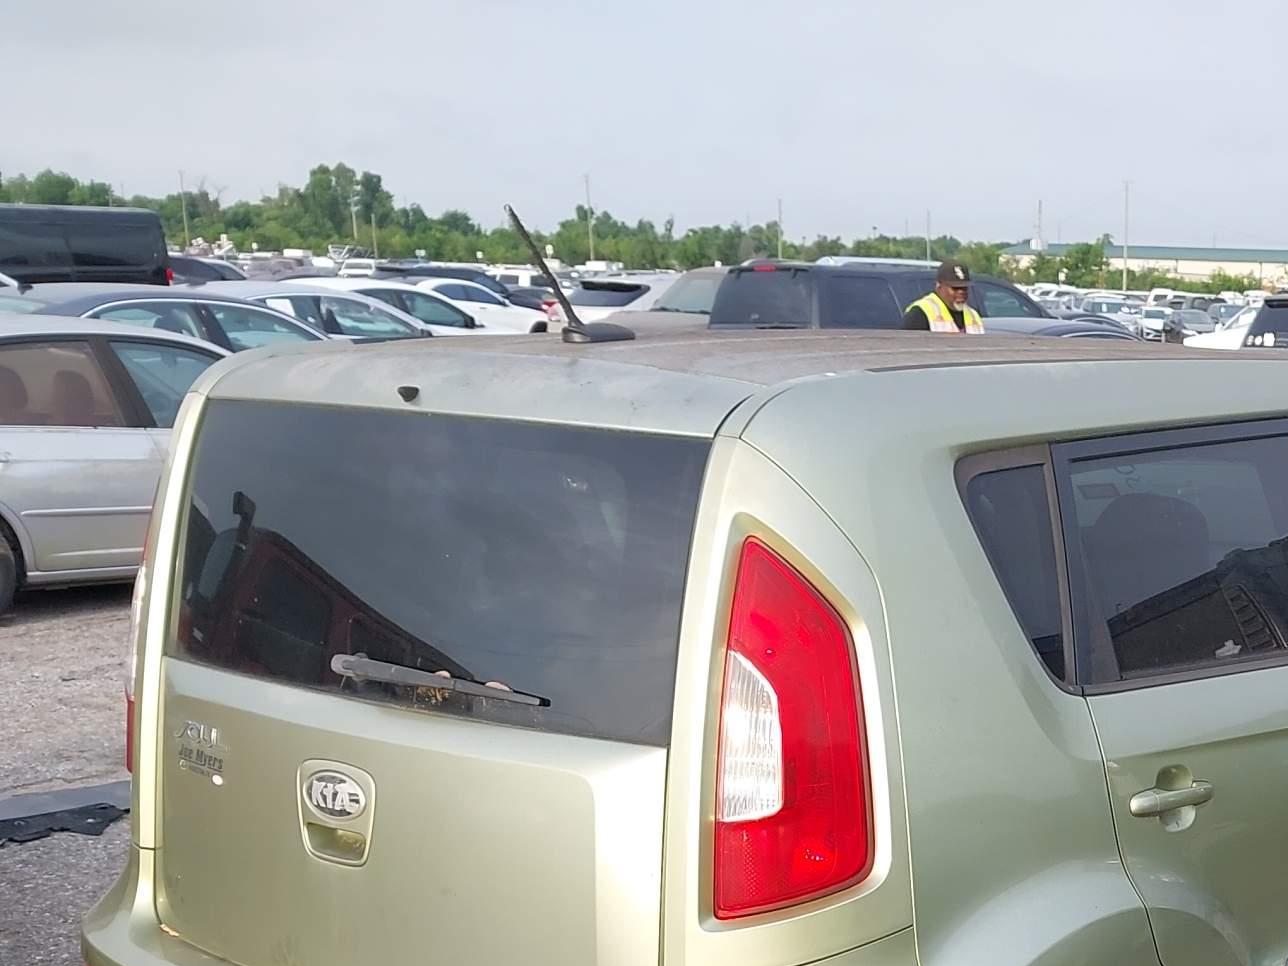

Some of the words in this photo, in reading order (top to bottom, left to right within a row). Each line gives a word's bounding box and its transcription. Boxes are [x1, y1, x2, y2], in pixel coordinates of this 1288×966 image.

[178, 744, 194, 760] Joe
[195, 748, 224, 770] Myers
[311, 779, 358, 813] KIA
